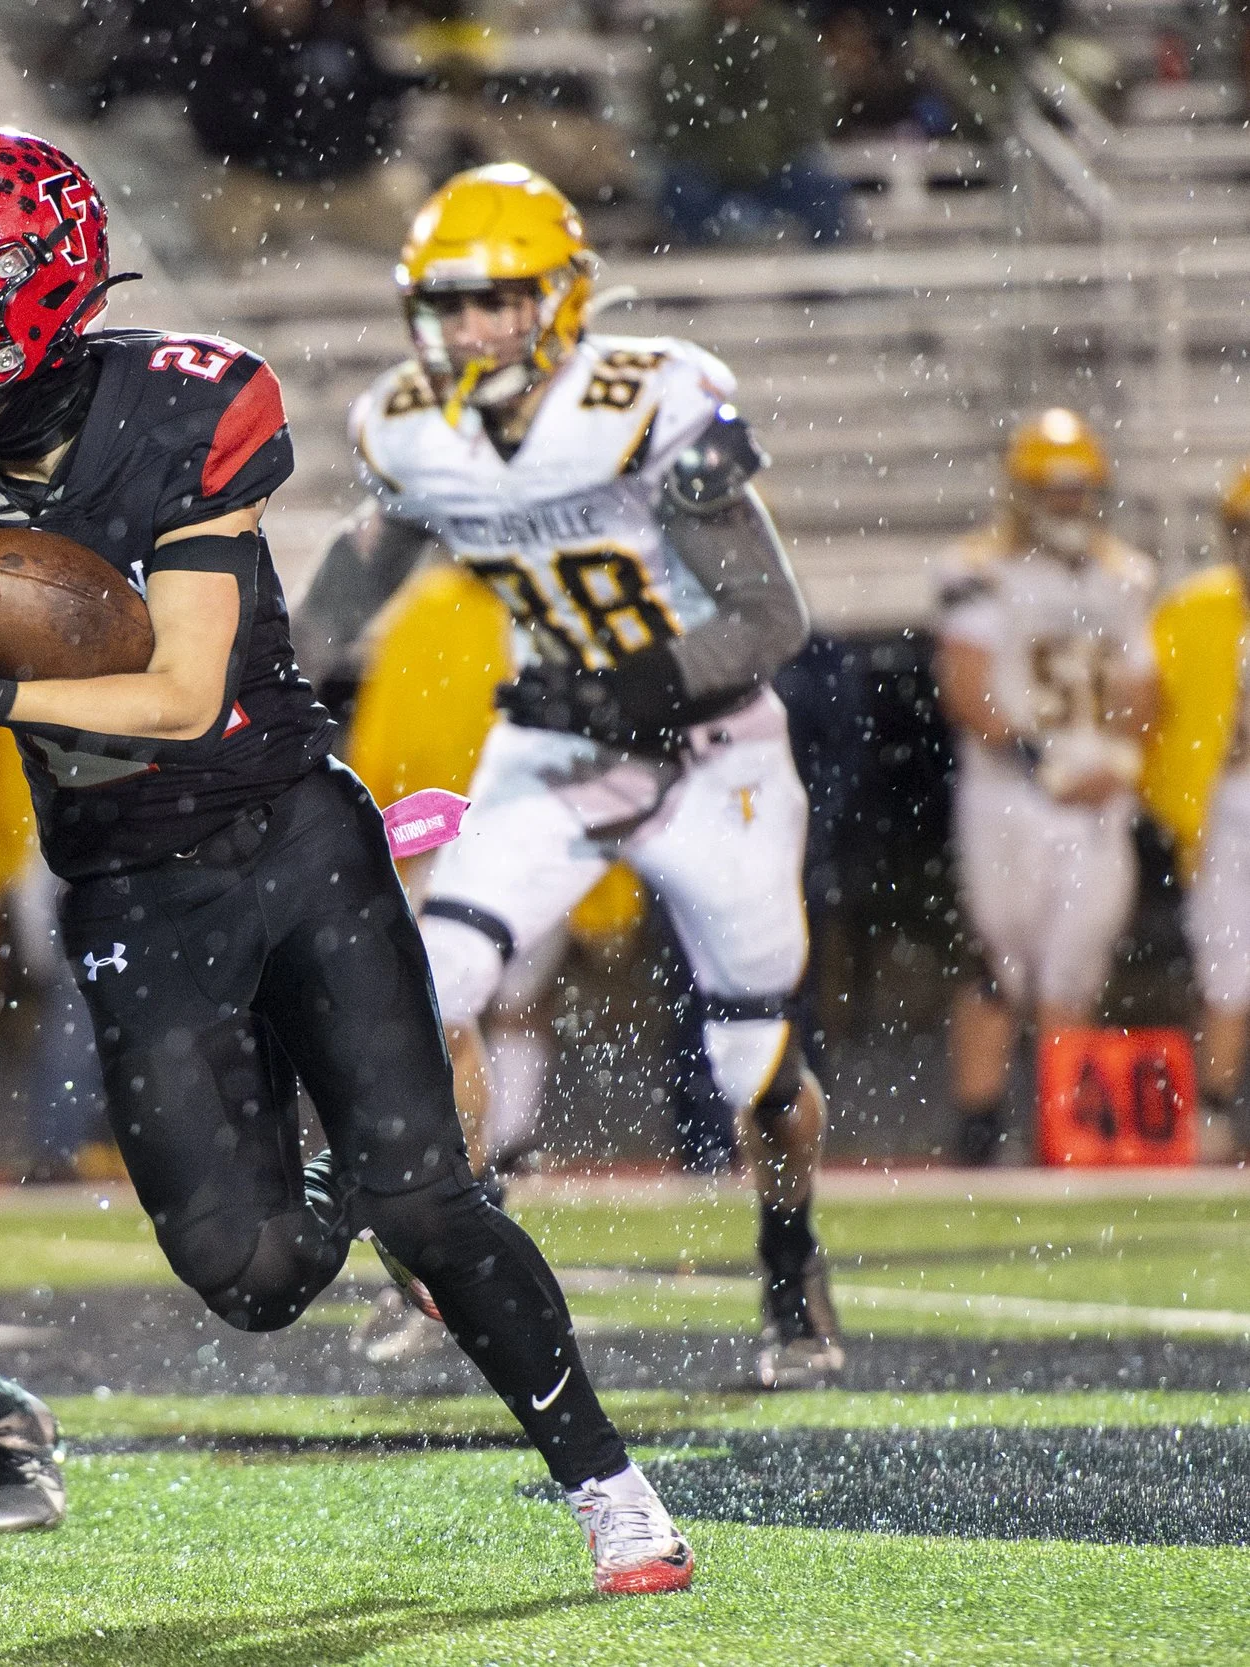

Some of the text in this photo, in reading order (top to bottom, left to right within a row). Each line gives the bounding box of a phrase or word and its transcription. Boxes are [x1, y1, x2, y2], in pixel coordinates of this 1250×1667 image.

[38, 171, 88, 266] F
[390, 818, 427, 844] NXTRND
[1072, 1055, 1177, 1146] 40
